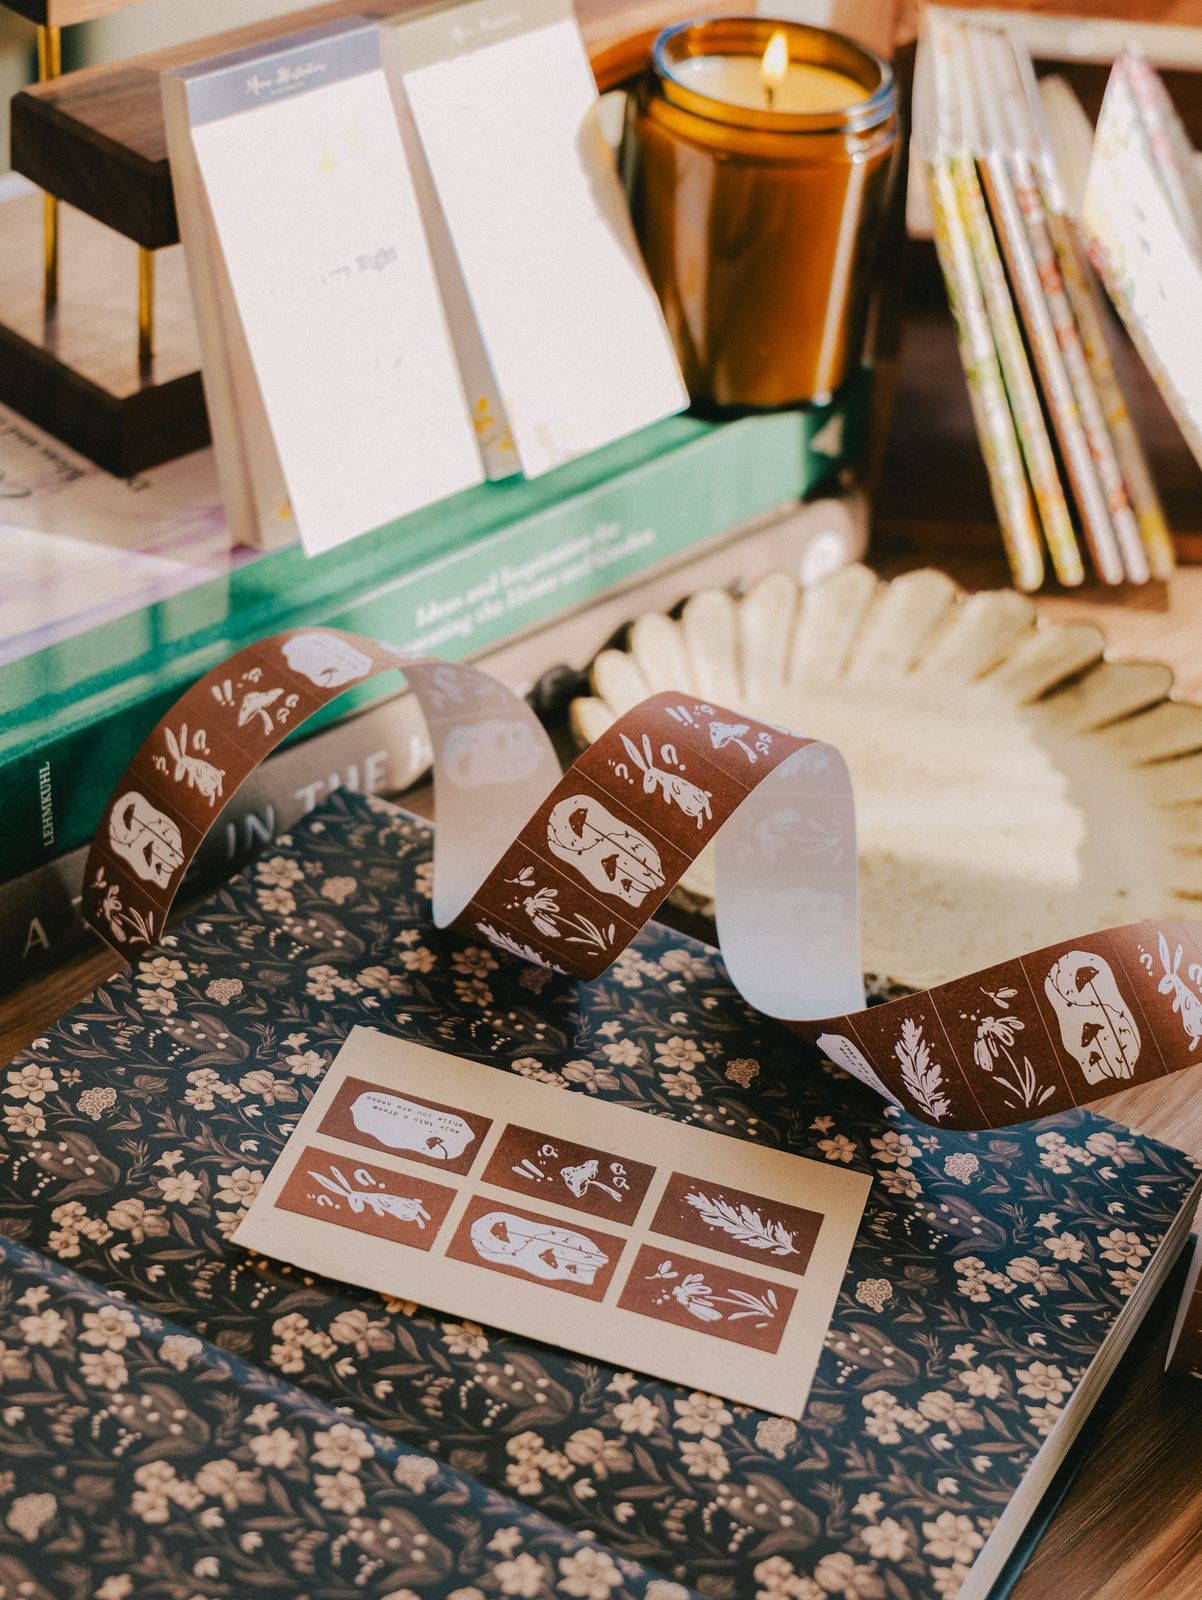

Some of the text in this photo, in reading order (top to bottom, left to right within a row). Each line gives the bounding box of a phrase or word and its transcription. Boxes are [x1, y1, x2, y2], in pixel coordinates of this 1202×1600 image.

[414, 594, 463, 629] Ideas
[466, 571, 500, 602] and
[474, 599, 504, 625] the
[37, 760, 55, 848] LEHMKUHL
[225, 803, 276, 859] IN
[293, 750, 389, 814] THE
[366, 1095, 463, 1128] while you are awake
[372, 1105, 398, 1117] dream
[413, 1117, 434, 1127] into
[439, 1123, 460, 1135] walk
